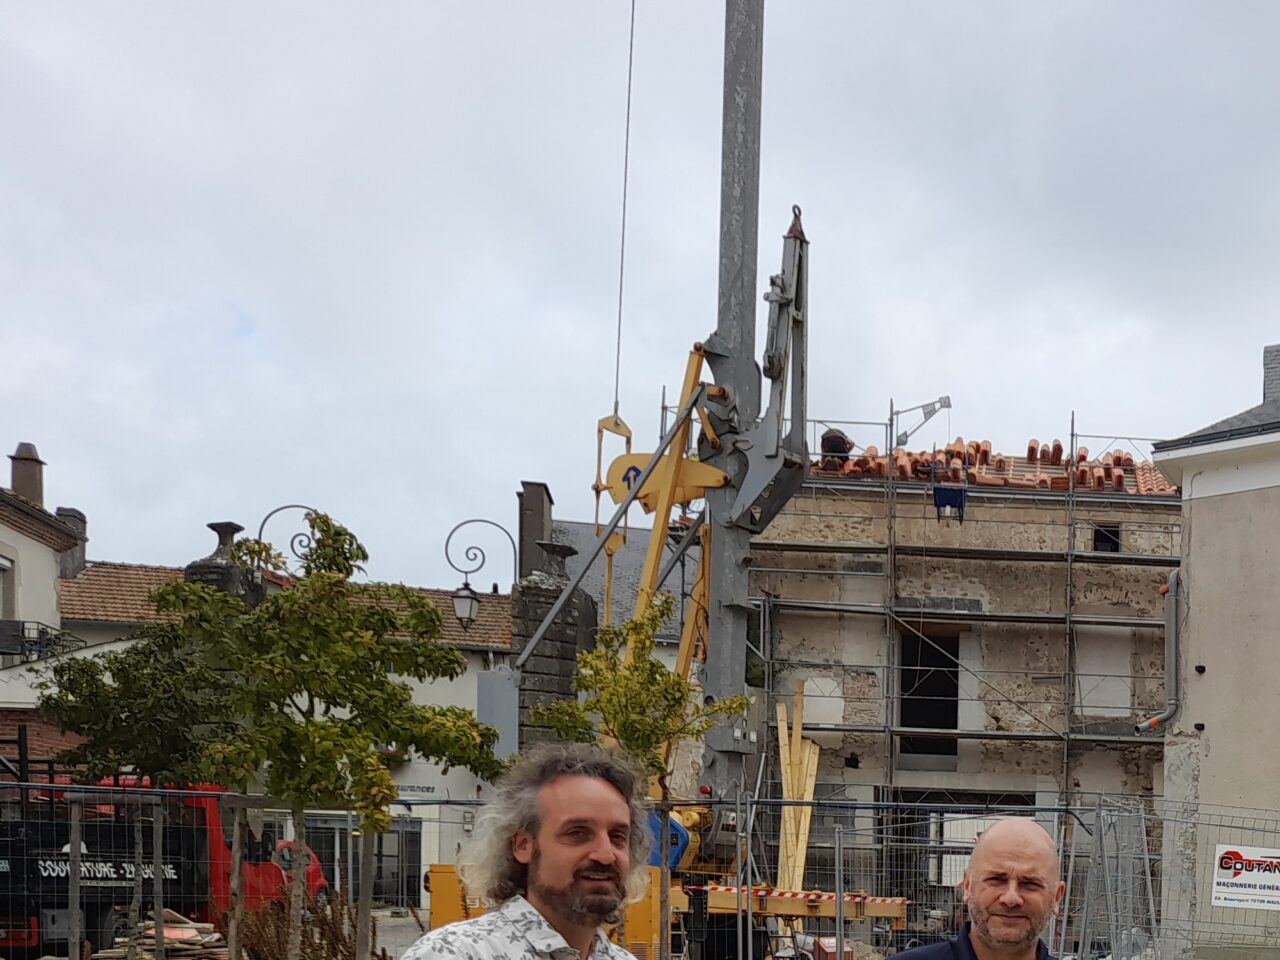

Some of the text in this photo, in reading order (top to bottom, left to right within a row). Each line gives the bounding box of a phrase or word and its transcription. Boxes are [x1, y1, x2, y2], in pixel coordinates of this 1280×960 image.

[396, 785, 436, 793] surances
[38, 861, 117, 878] COUVRTURE
[1216, 881, 1257, 889] MAÇONNERIE
